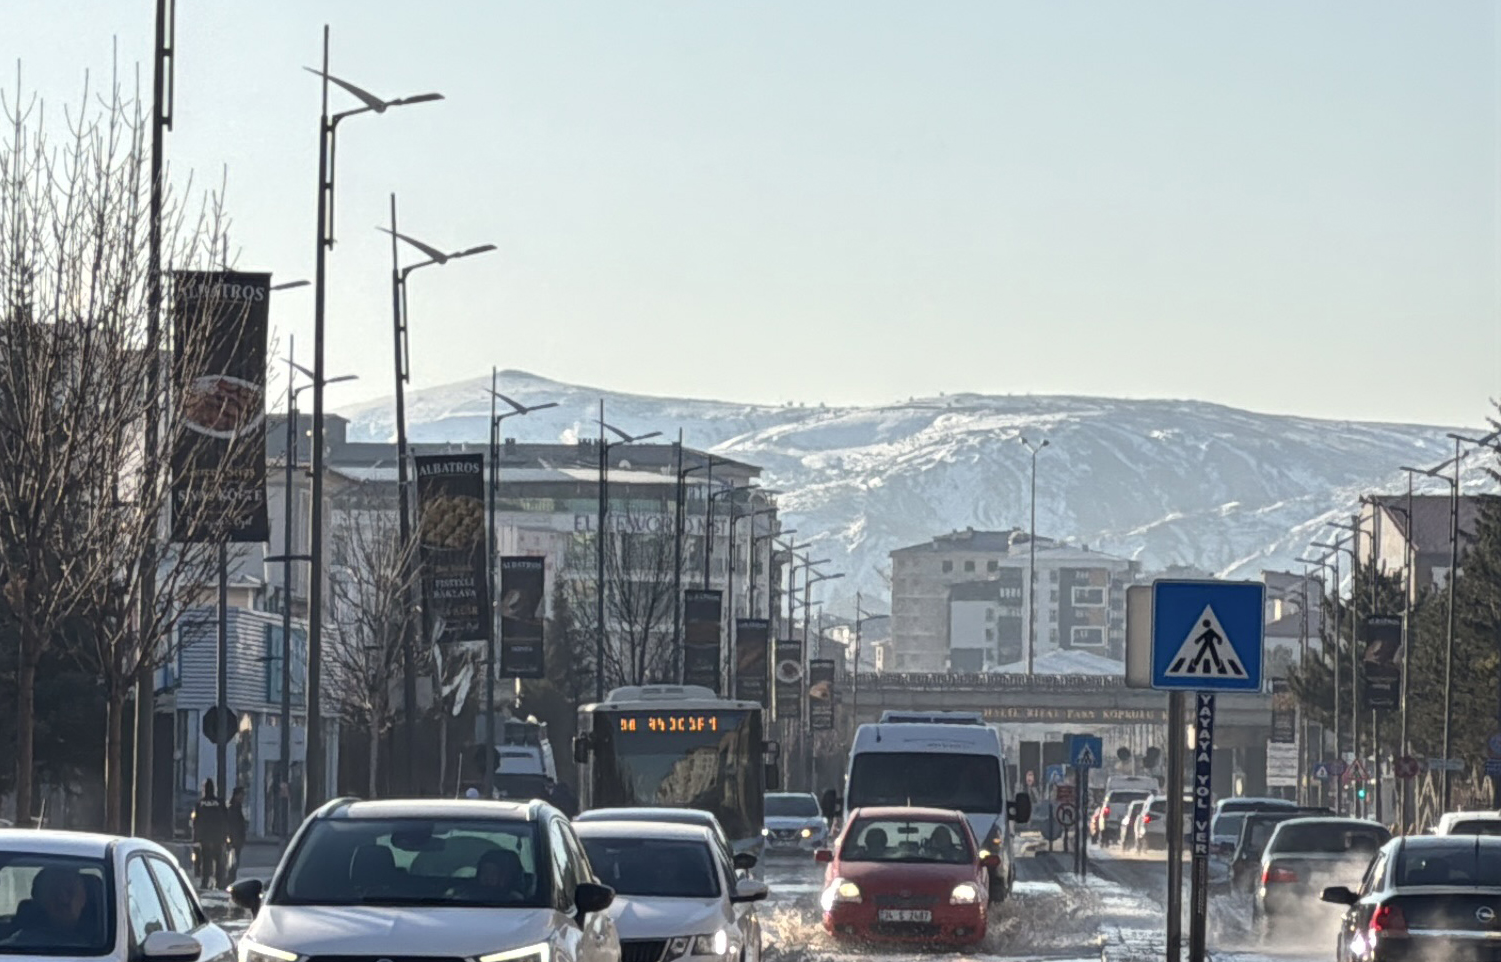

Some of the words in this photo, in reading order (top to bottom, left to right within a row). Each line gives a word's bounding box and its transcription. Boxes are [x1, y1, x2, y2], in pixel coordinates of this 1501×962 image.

[419, 461, 480, 476] ALBATROS
[1197, 694, 1212, 763] YAYAYA
[1196, 774, 1210, 809] YOL
[1195, 820, 1208, 854] VER
